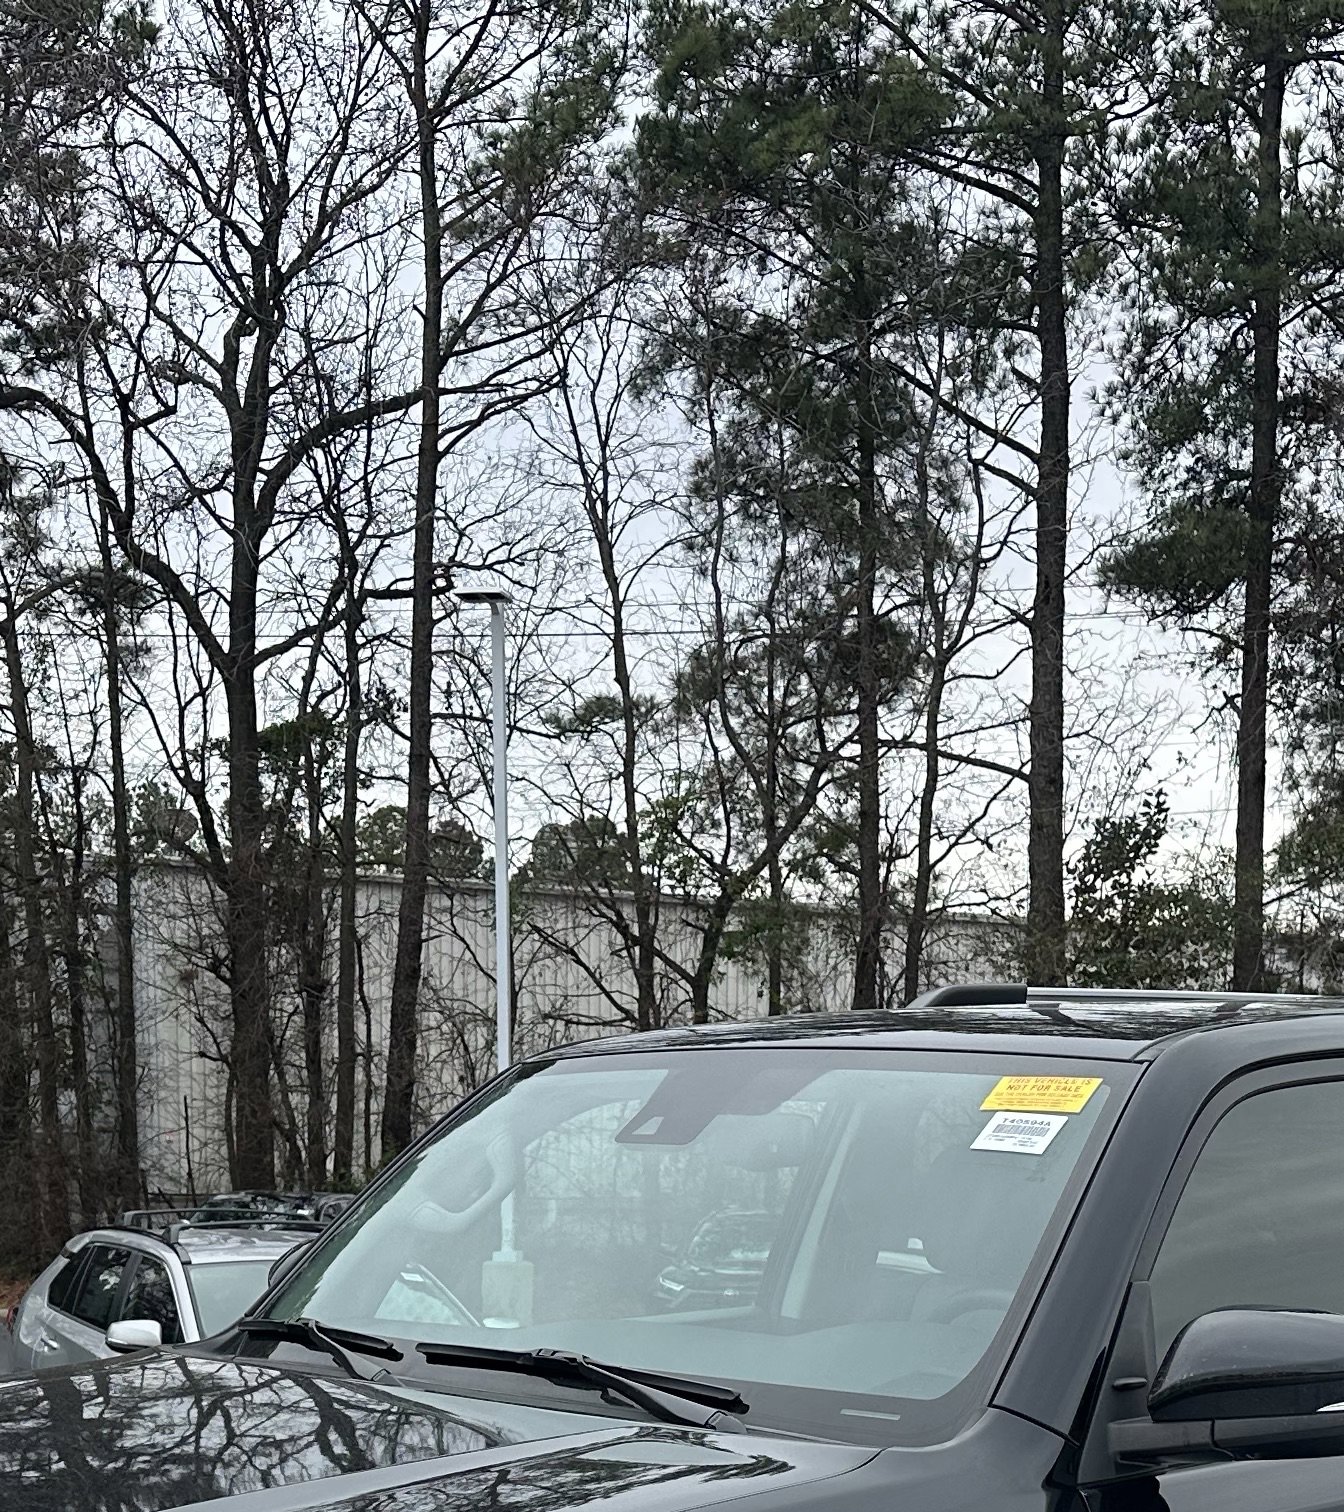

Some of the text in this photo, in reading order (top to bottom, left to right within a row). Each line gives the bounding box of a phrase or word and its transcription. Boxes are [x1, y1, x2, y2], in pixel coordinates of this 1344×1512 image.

[1081, 1078, 1093, 1086] IS
[1030, 1084, 1051, 1092] FOR
[1054, 1085, 1083, 1093] SALE
